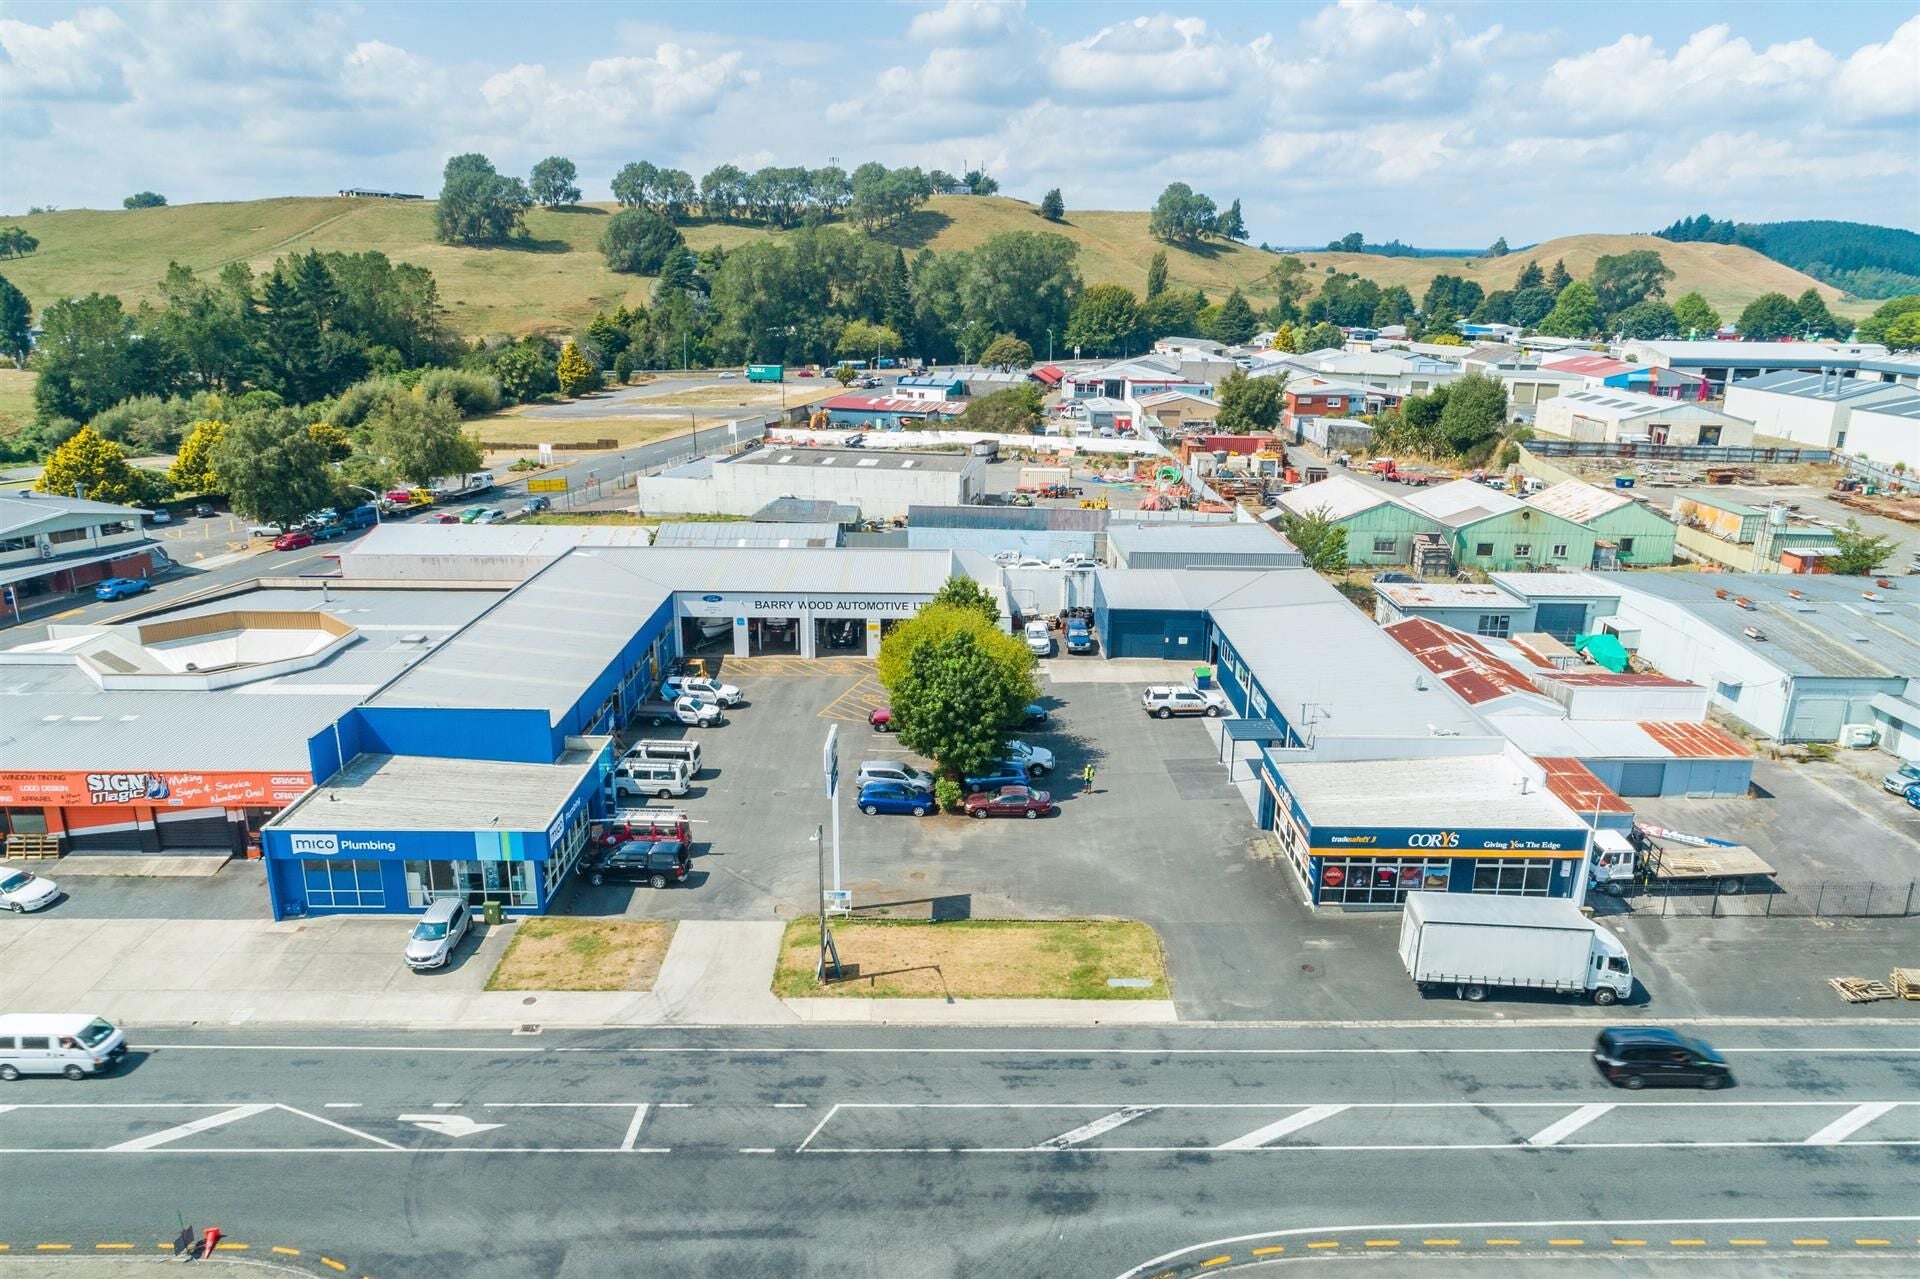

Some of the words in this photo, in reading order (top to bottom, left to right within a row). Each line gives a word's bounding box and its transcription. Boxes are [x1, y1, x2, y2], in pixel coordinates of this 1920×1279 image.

[754, 600, 793, 609] BARRY
[797, 601, 833, 610] WOOD
[836, 601, 909, 610] AUTOMOTIVE
[86, 772, 146, 791] SIGN
[168, 774, 203, 786] Making
[175, 786, 202, 798] Signs
[215, 780, 253, 792] Service
[210, 793, 243, 804] Number
[295, 839, 335, 849] mico
[340, 840, 396, 852] Plumbing
[1408, 832, 1460, 848] CORYS
[1483, 840, 1508, 850] Giving
[1510, 840, 1524, 849] You
[1525, 841, 1540, 849] The
[1541, 841, 1561, 850] Edge
